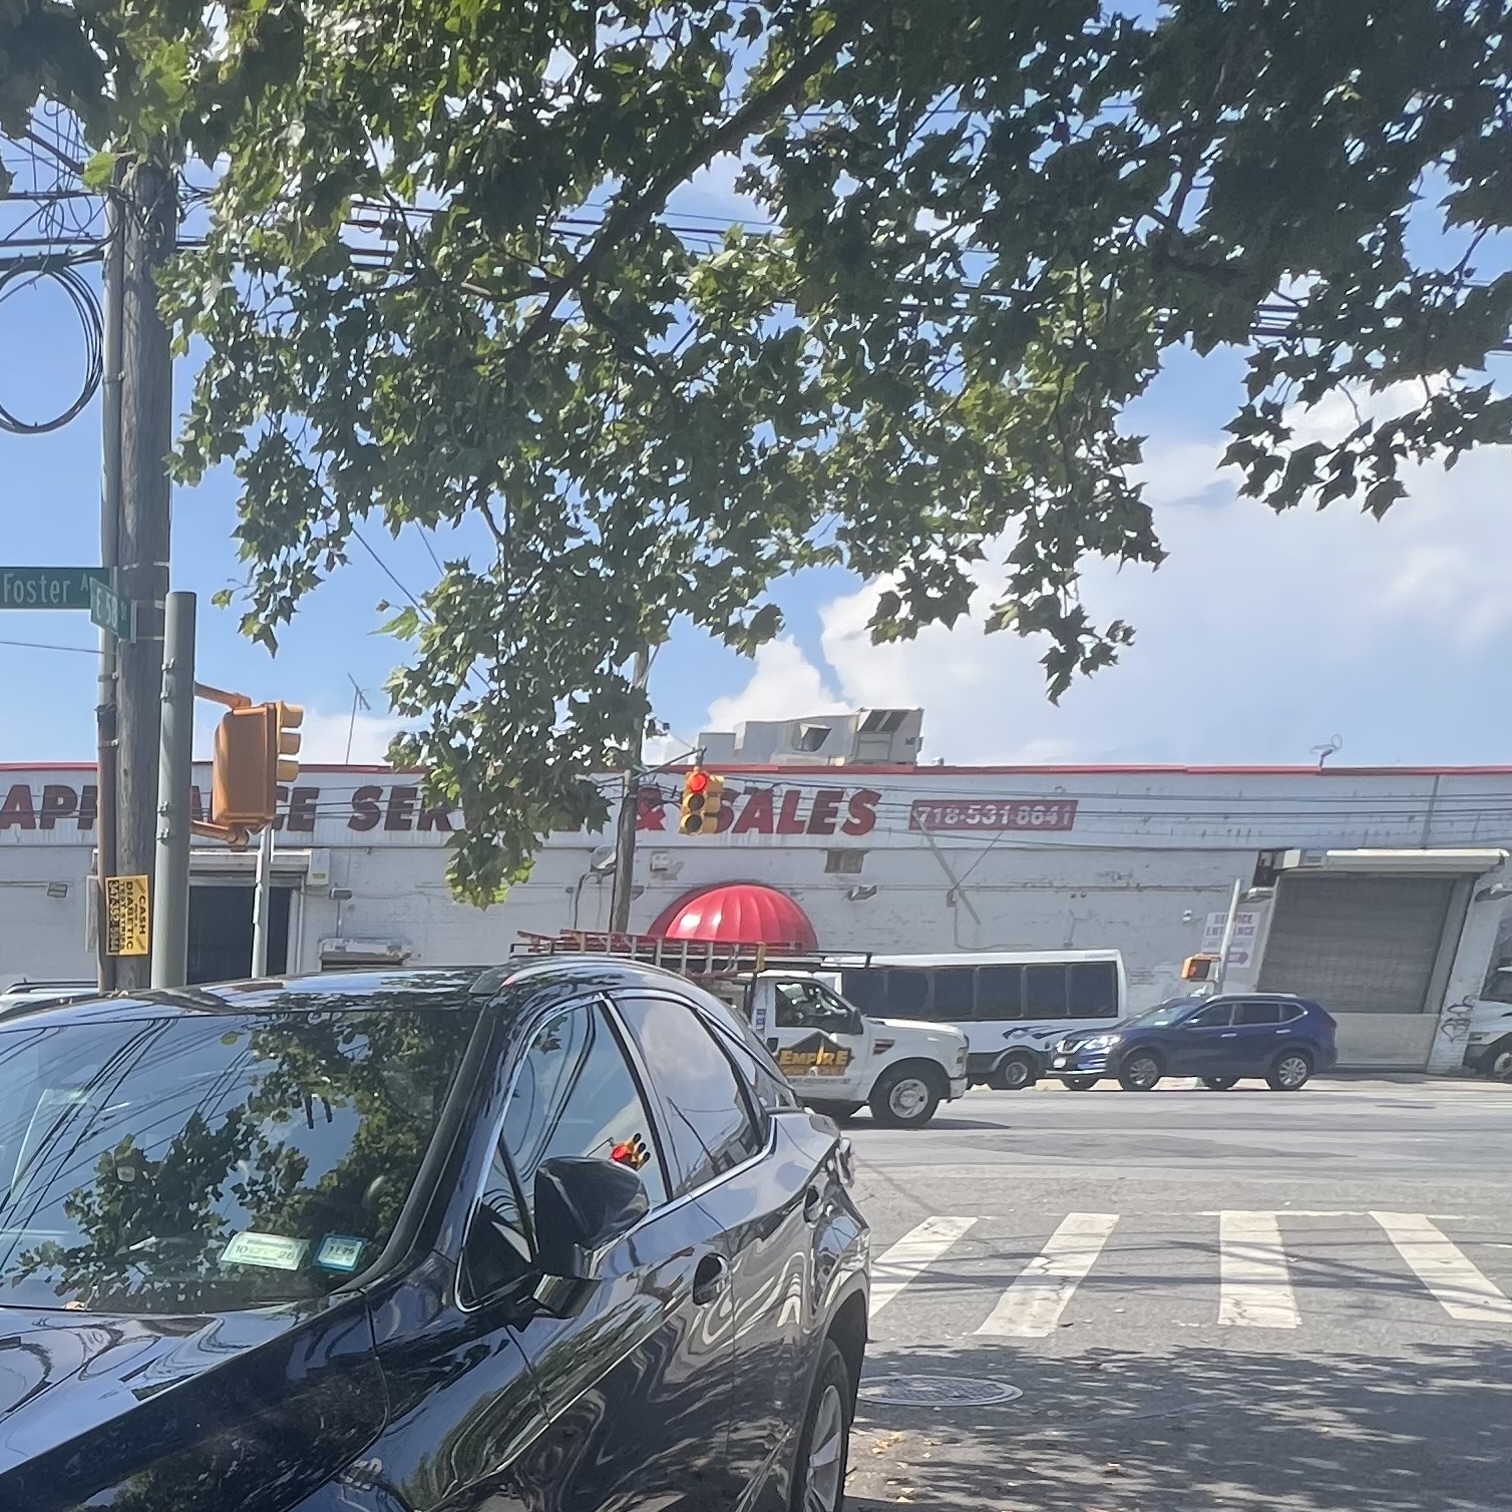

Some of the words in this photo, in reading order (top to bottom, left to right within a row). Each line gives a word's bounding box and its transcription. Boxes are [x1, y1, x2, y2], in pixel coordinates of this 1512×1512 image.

[3, 573, 71, 604] Foster
[96, 587, 102, 620] E
[106, 592, 119, 630] 58
[126, 881, 134, 950] DIABETIC
